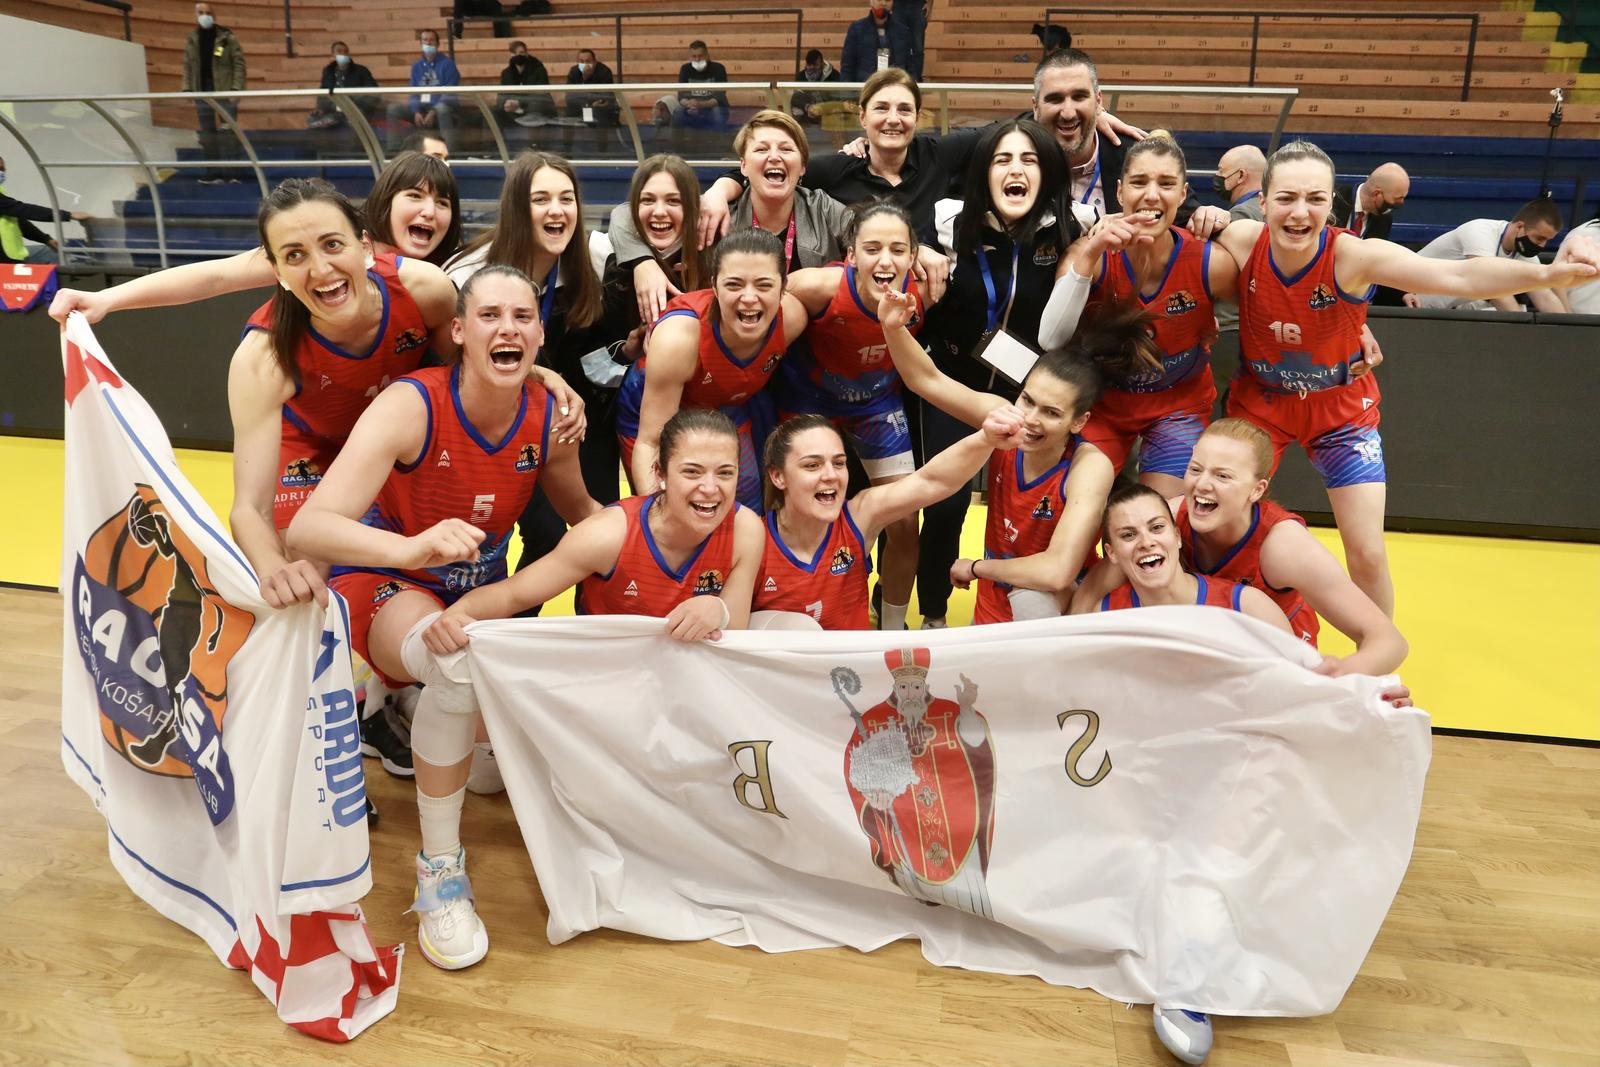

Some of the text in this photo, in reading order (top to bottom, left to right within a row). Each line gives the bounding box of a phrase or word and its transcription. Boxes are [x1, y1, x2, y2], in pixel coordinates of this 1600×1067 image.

[1166, 302, 1197, 312] RAGSA
[1268, 320, 1303, 346] 16
[857, 343, 888, 366] 15
[1252, 362, 1340, 381] DUROVNIK
[282, 475, 323, 483] RAGSA
[470, 493, 497, 524] 5
[693, 584, 723, 593] RAGSA
[78, 574, 225, 792] RAGSA
[306, 696, 332, 832] SPORT
[321, 688, 368, 828] ARDU
